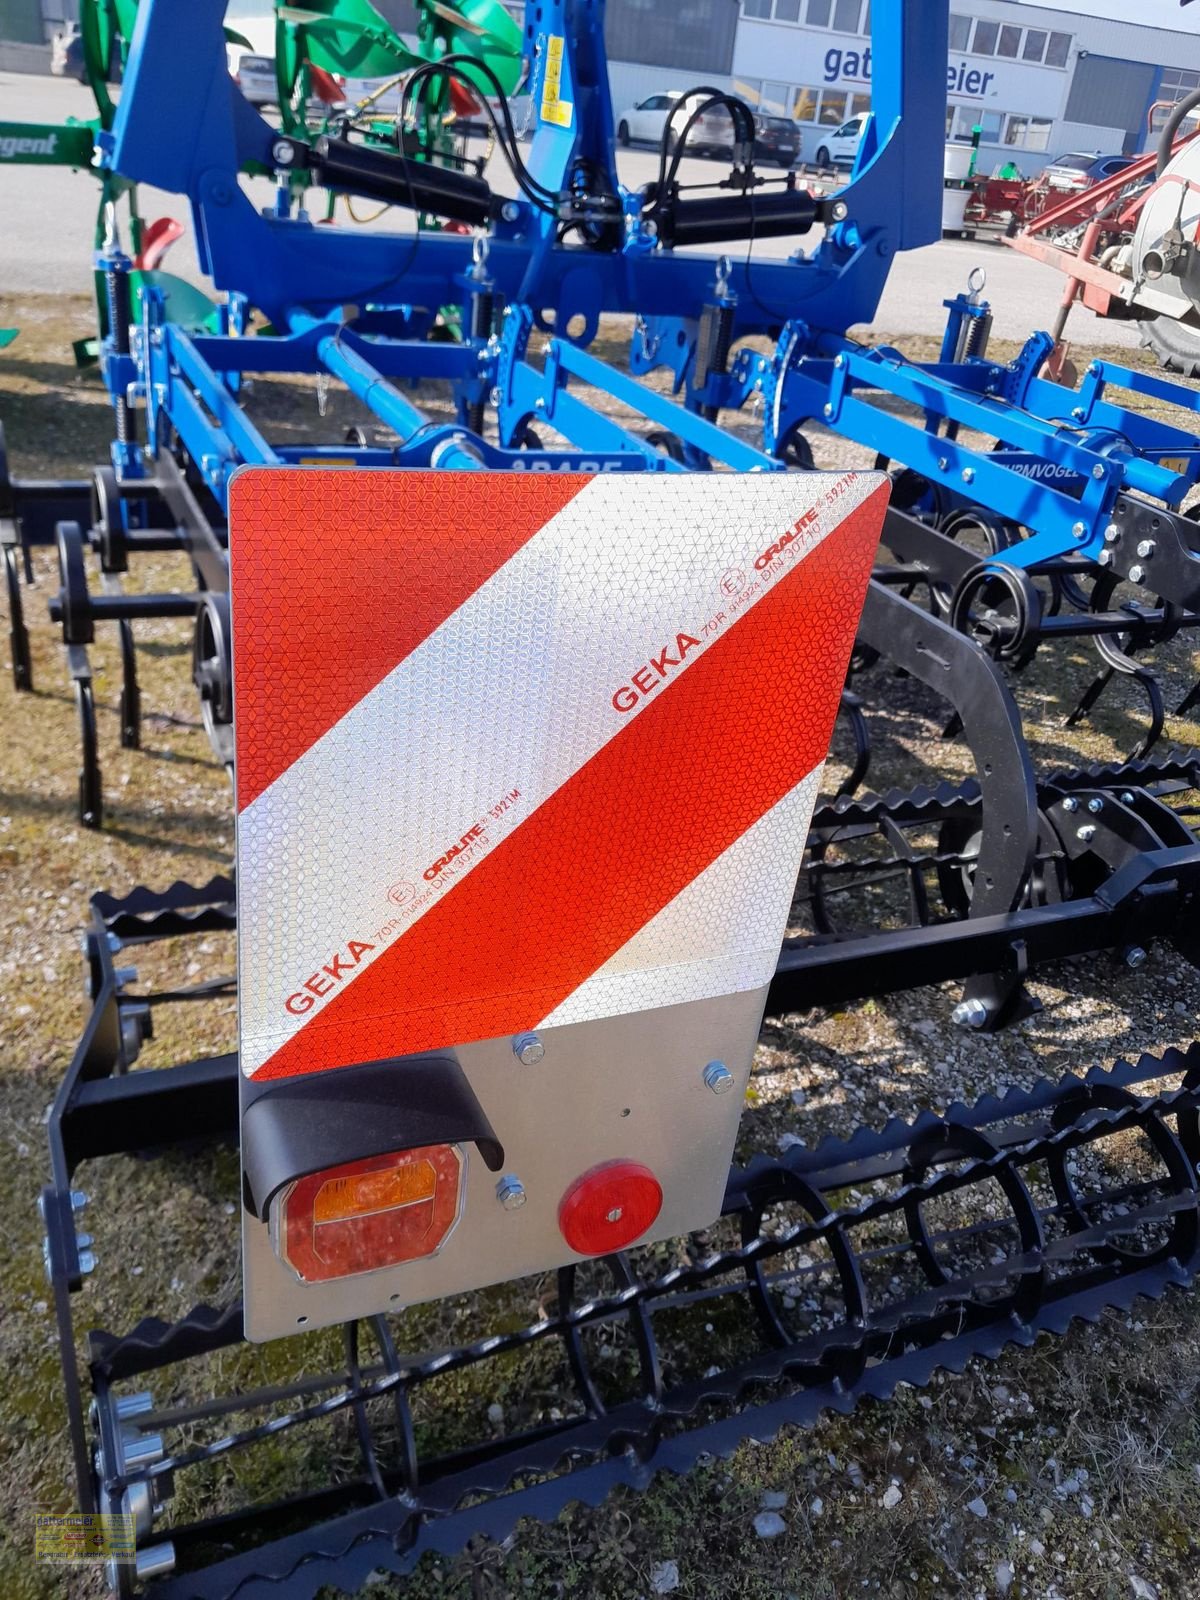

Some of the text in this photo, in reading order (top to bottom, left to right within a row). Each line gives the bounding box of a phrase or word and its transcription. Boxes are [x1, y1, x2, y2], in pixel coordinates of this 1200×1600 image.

[611, 633, 702, 713] GEKA
[760, 560, 784, 582] DIN
[784, 523, 821, 558] 30710
[284, 940, 376, 1015] GEKA
[431, 867, 455, 890] DIN
[454, 835, 489, 869] 30710
